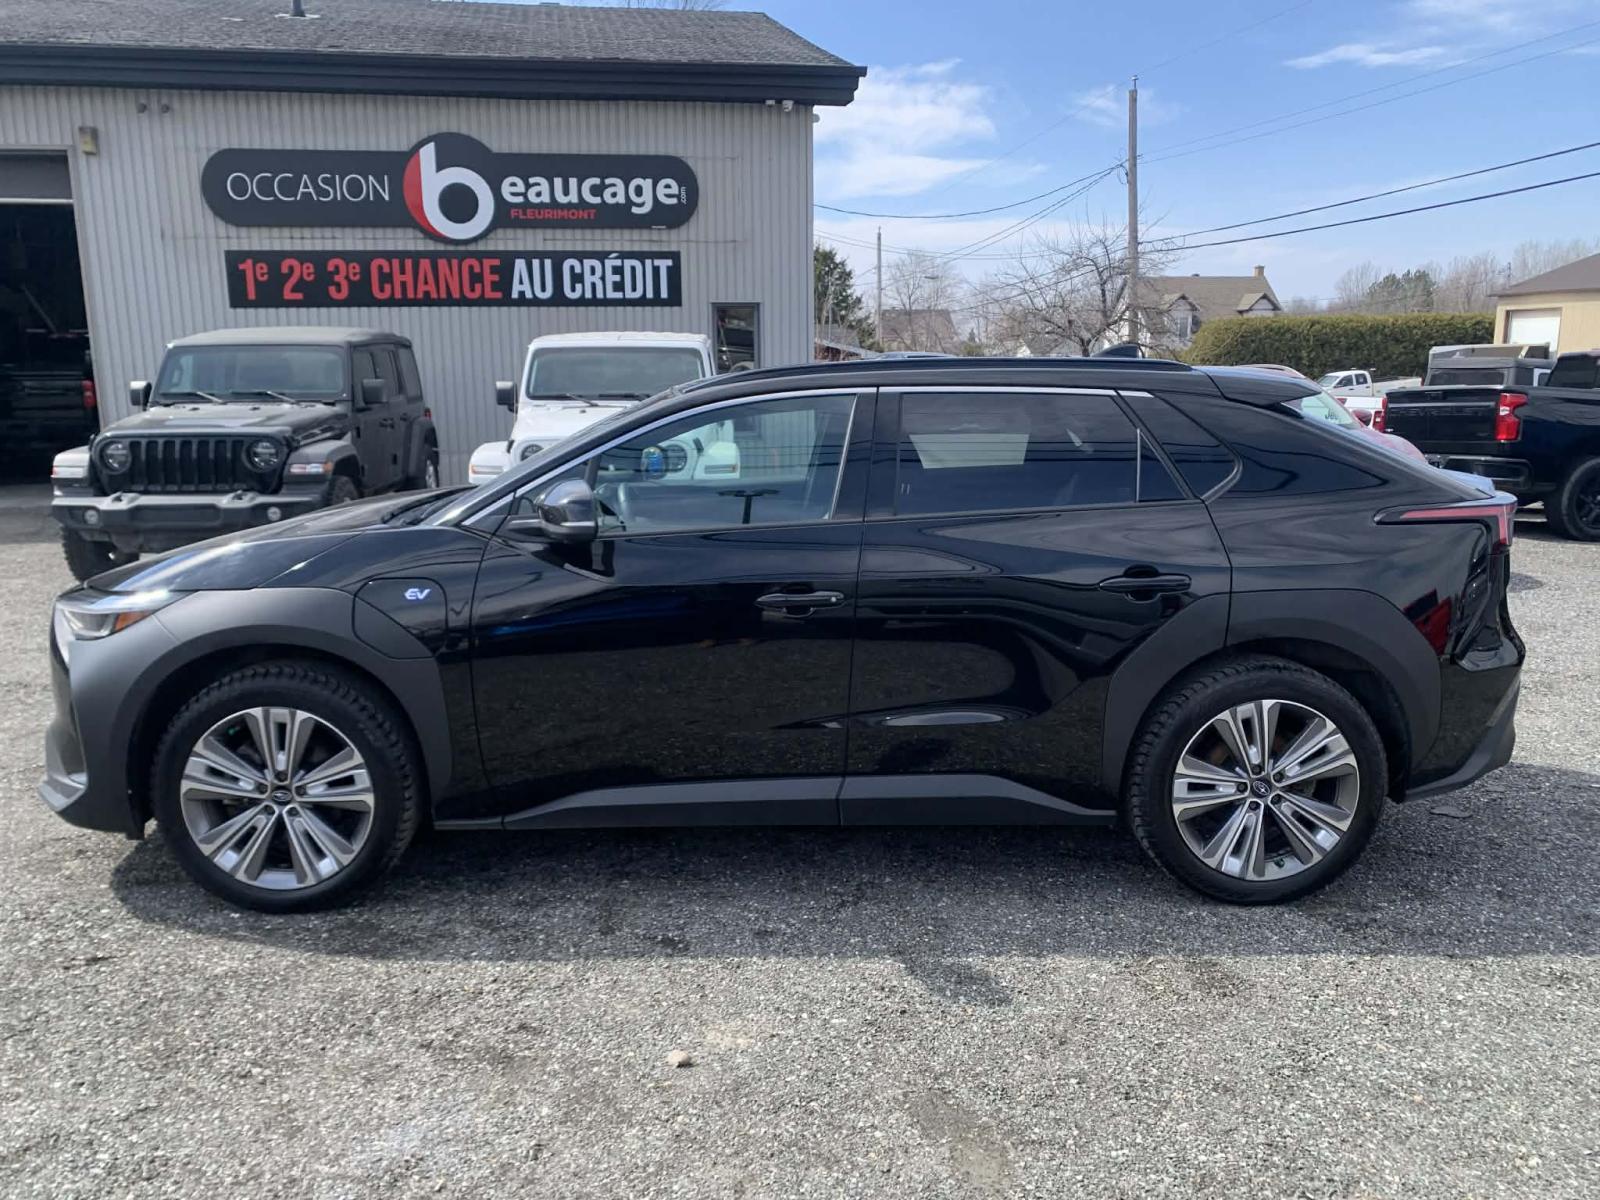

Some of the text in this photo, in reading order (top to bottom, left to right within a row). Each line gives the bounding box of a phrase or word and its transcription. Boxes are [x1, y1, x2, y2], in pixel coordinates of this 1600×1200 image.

[226, 172, 390, 201] OCCASION
[510, 208, 597, 220] FLEURIMONT
[370, 258, 502, 300] CHANCE
[511, 258, 554, 299] AU
[562, 252, 673, 299] CRÉDIT
[404, 588, 431, 600] EV
